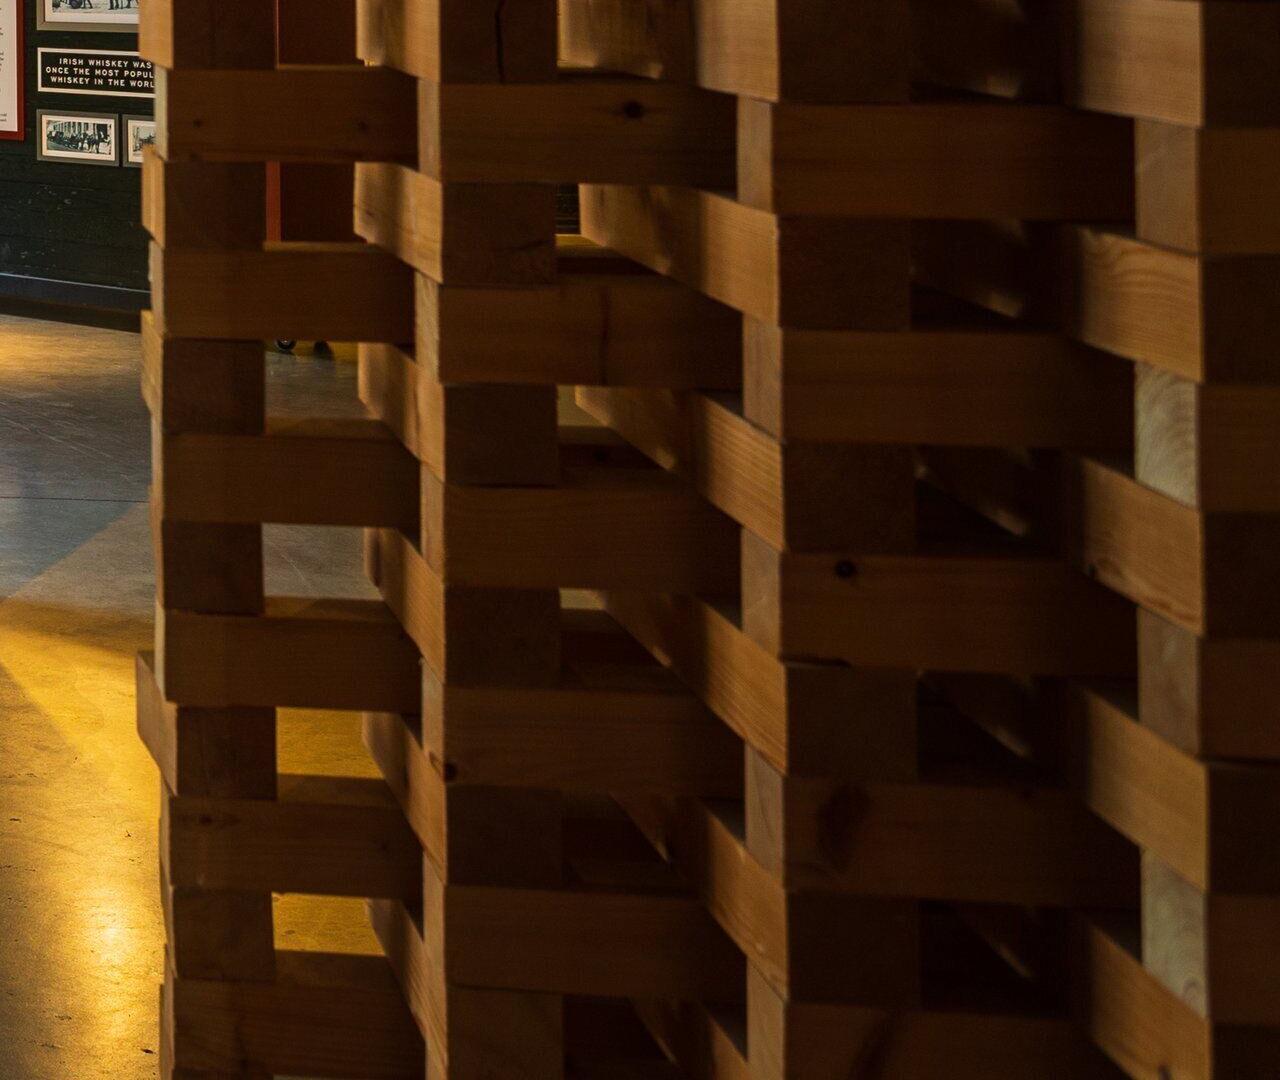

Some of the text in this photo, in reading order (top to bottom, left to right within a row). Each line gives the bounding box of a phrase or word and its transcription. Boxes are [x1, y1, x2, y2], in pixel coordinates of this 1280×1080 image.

[59, 57, 153, 69] IRISH WHISKEY WAS
[45, 66, 154, 79] ONCE THE MOST POPUL
[50, 76, 90, 85] WHISKEY
[108, 78, 125, 87] THE
[129, 80, 155, 88] WORL
